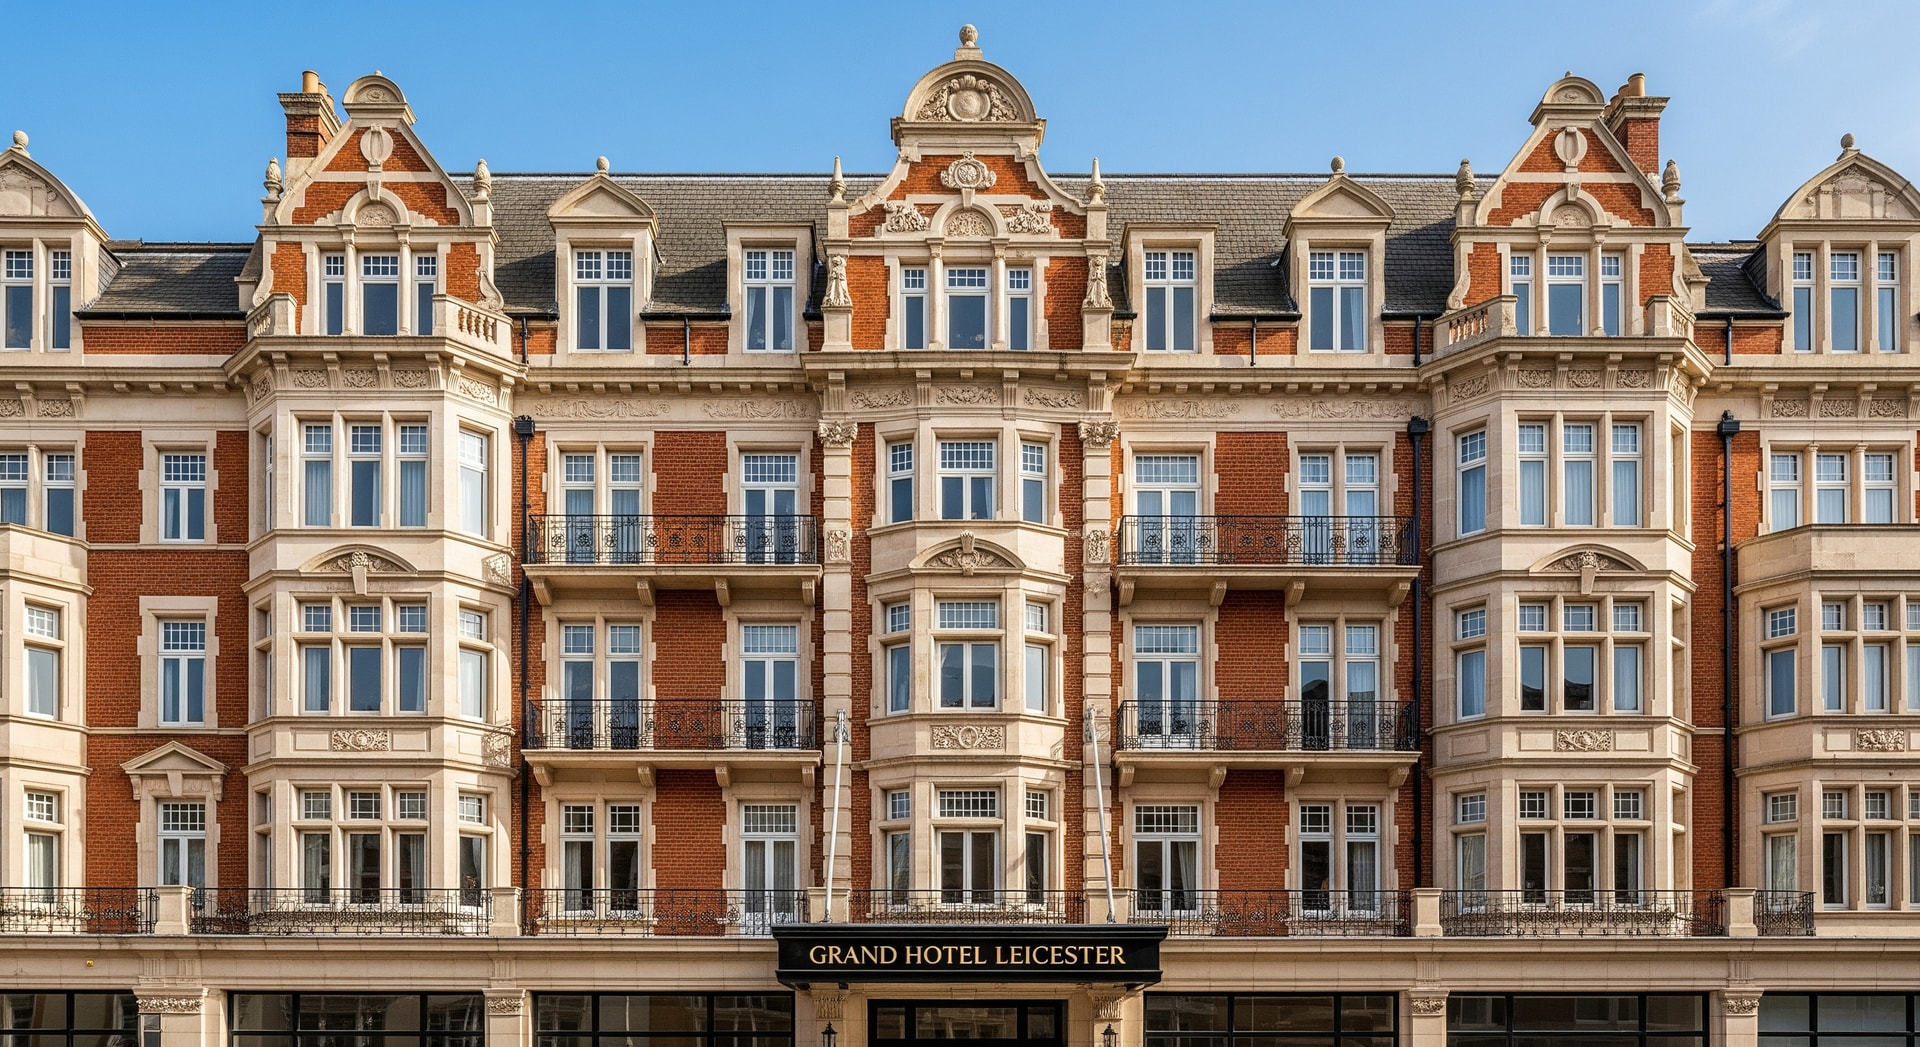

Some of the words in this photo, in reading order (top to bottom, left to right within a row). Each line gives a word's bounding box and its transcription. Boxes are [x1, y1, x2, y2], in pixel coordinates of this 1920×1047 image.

[809, 945, 898, 965] GRAND
[905, 945, 987, 965] HOTEL
[995, 945, 1127, 965] LEICESTER
